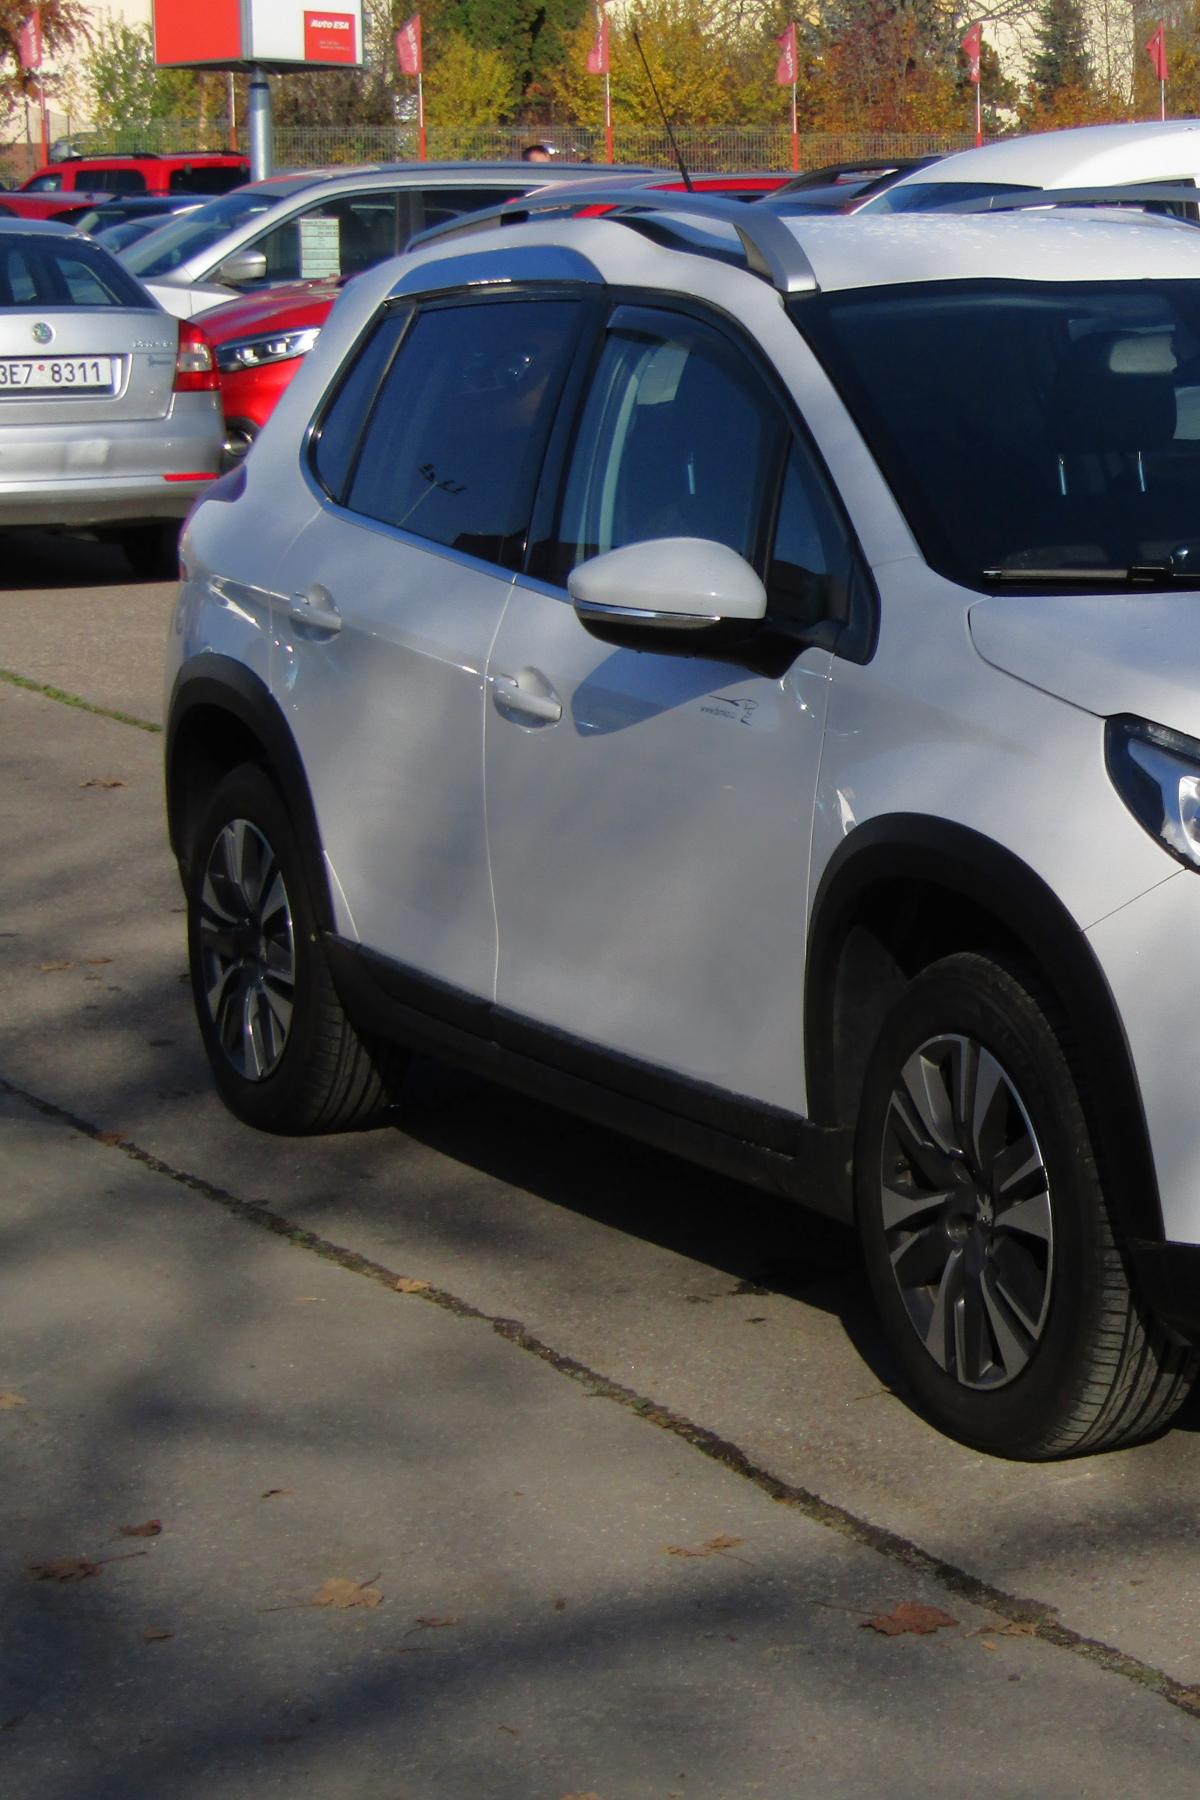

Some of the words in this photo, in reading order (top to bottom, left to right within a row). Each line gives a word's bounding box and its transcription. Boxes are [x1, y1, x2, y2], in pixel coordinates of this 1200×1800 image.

[311, 19, 333, 29] Auto
[333, 20, 350, 30] ESA
[0, 364, 33, 385] 3E7
[51, 362, 101, 383] 8311
